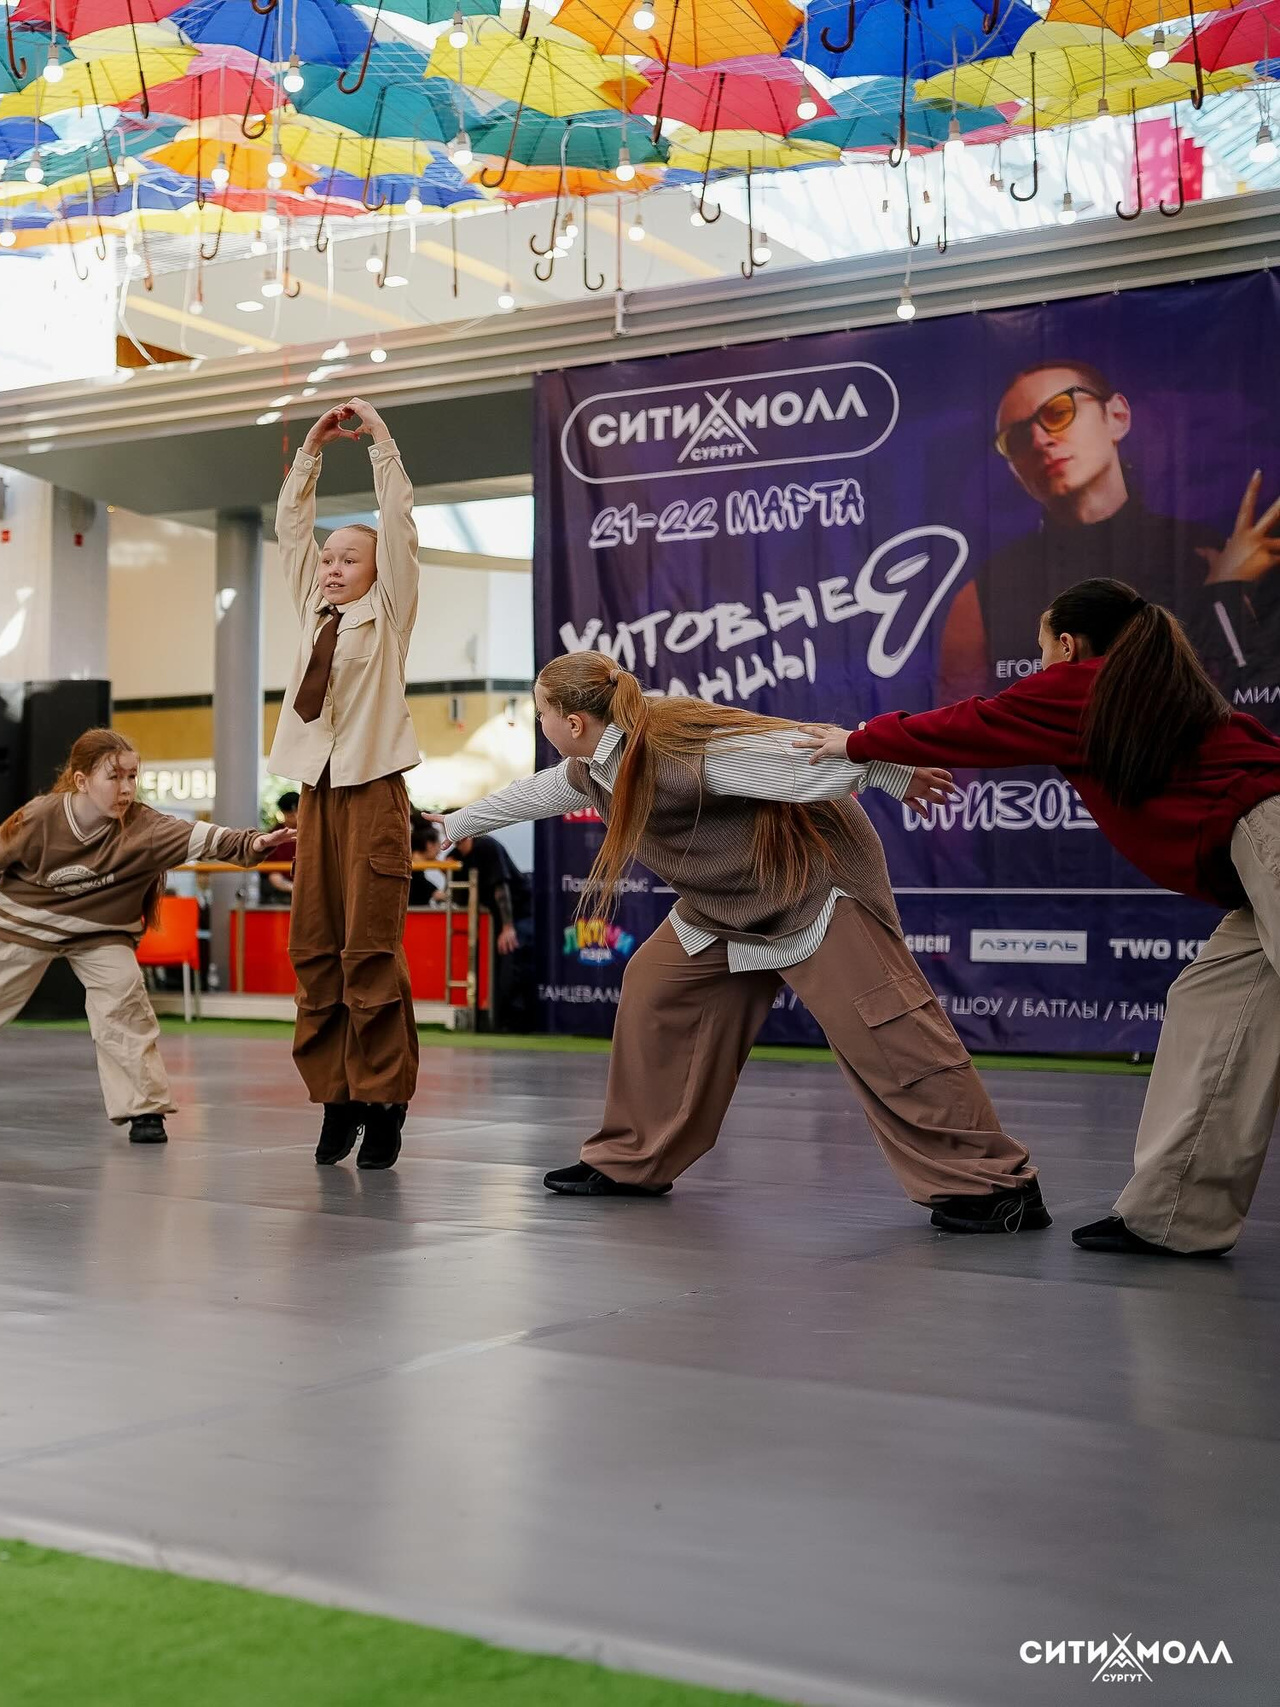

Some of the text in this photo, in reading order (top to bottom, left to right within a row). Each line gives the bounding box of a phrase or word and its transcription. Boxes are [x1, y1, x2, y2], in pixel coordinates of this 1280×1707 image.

[588, 383, 869, 447] СИТИ МОЛЛ
[690, 443, 745, 462] СУРГУТ
[588, 478, 865, 549] 21-22 МАРТА
[641, 637, 817, 702] АНЦЫ
[996, 659, 1043, 679] ЕГОР
[1109, 938, 1172, 960] TWO
[952, 995, 1004, 1016] ШОУ
